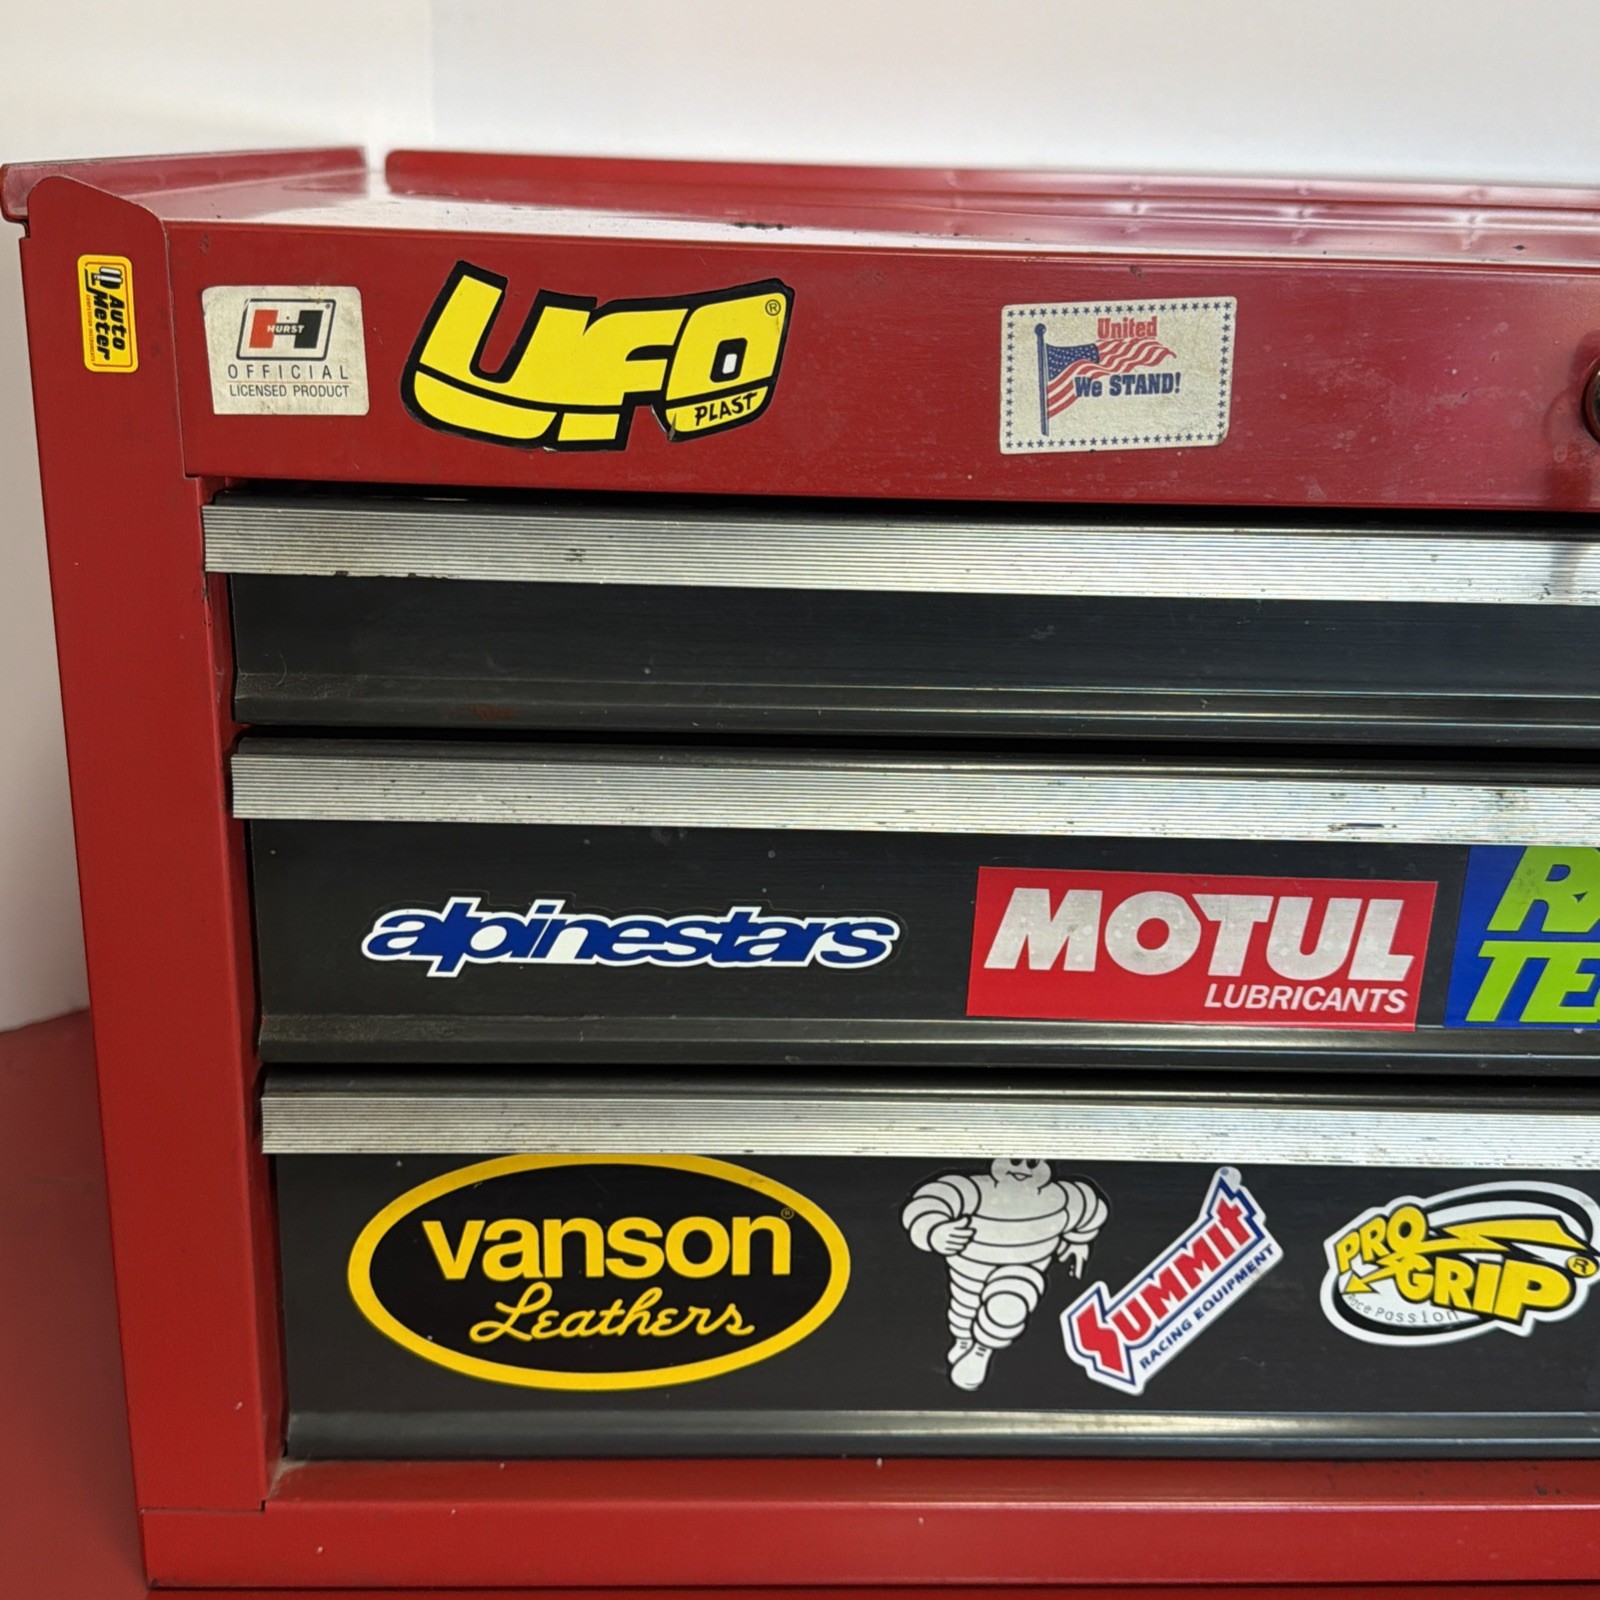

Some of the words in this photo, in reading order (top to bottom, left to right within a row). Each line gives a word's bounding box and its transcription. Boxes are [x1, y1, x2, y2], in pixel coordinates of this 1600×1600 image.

[91, 288, 111, 361] Meter
[108, 293, 127, 351] Auto
[266, 324, 306, 334] HURST
[1097, 316, 1158, 339] United
[227, 364, 349, 380] OFFICIAL
[412, 272, 788, 442] UFO
[1074, 376, 1103, 398] We
[1108, 372, 1182, 397] STAND!
[229, 384, 287, 398] LICENSED
[293, 384, 350, 398] PRODUCT
[693, 391, 757, 427] PLAST
[362, 897, 900, 977] alpinestars
[983, 887, 1415, 982] MOTUL
[1204, 983, 1408, 1014] LUBRICANTS
[421, 1216, 792, 1281] vanson
[1335, 1205, 1428, 1274] PRO
[469, 1281, 756, 1343] Leathers
[1139, 1318, 1193, 1370] RACING
[1193, 1243, 1275, 1321] EQUIPMENT
[1394, 1252, 1572, 1321] GRIP
